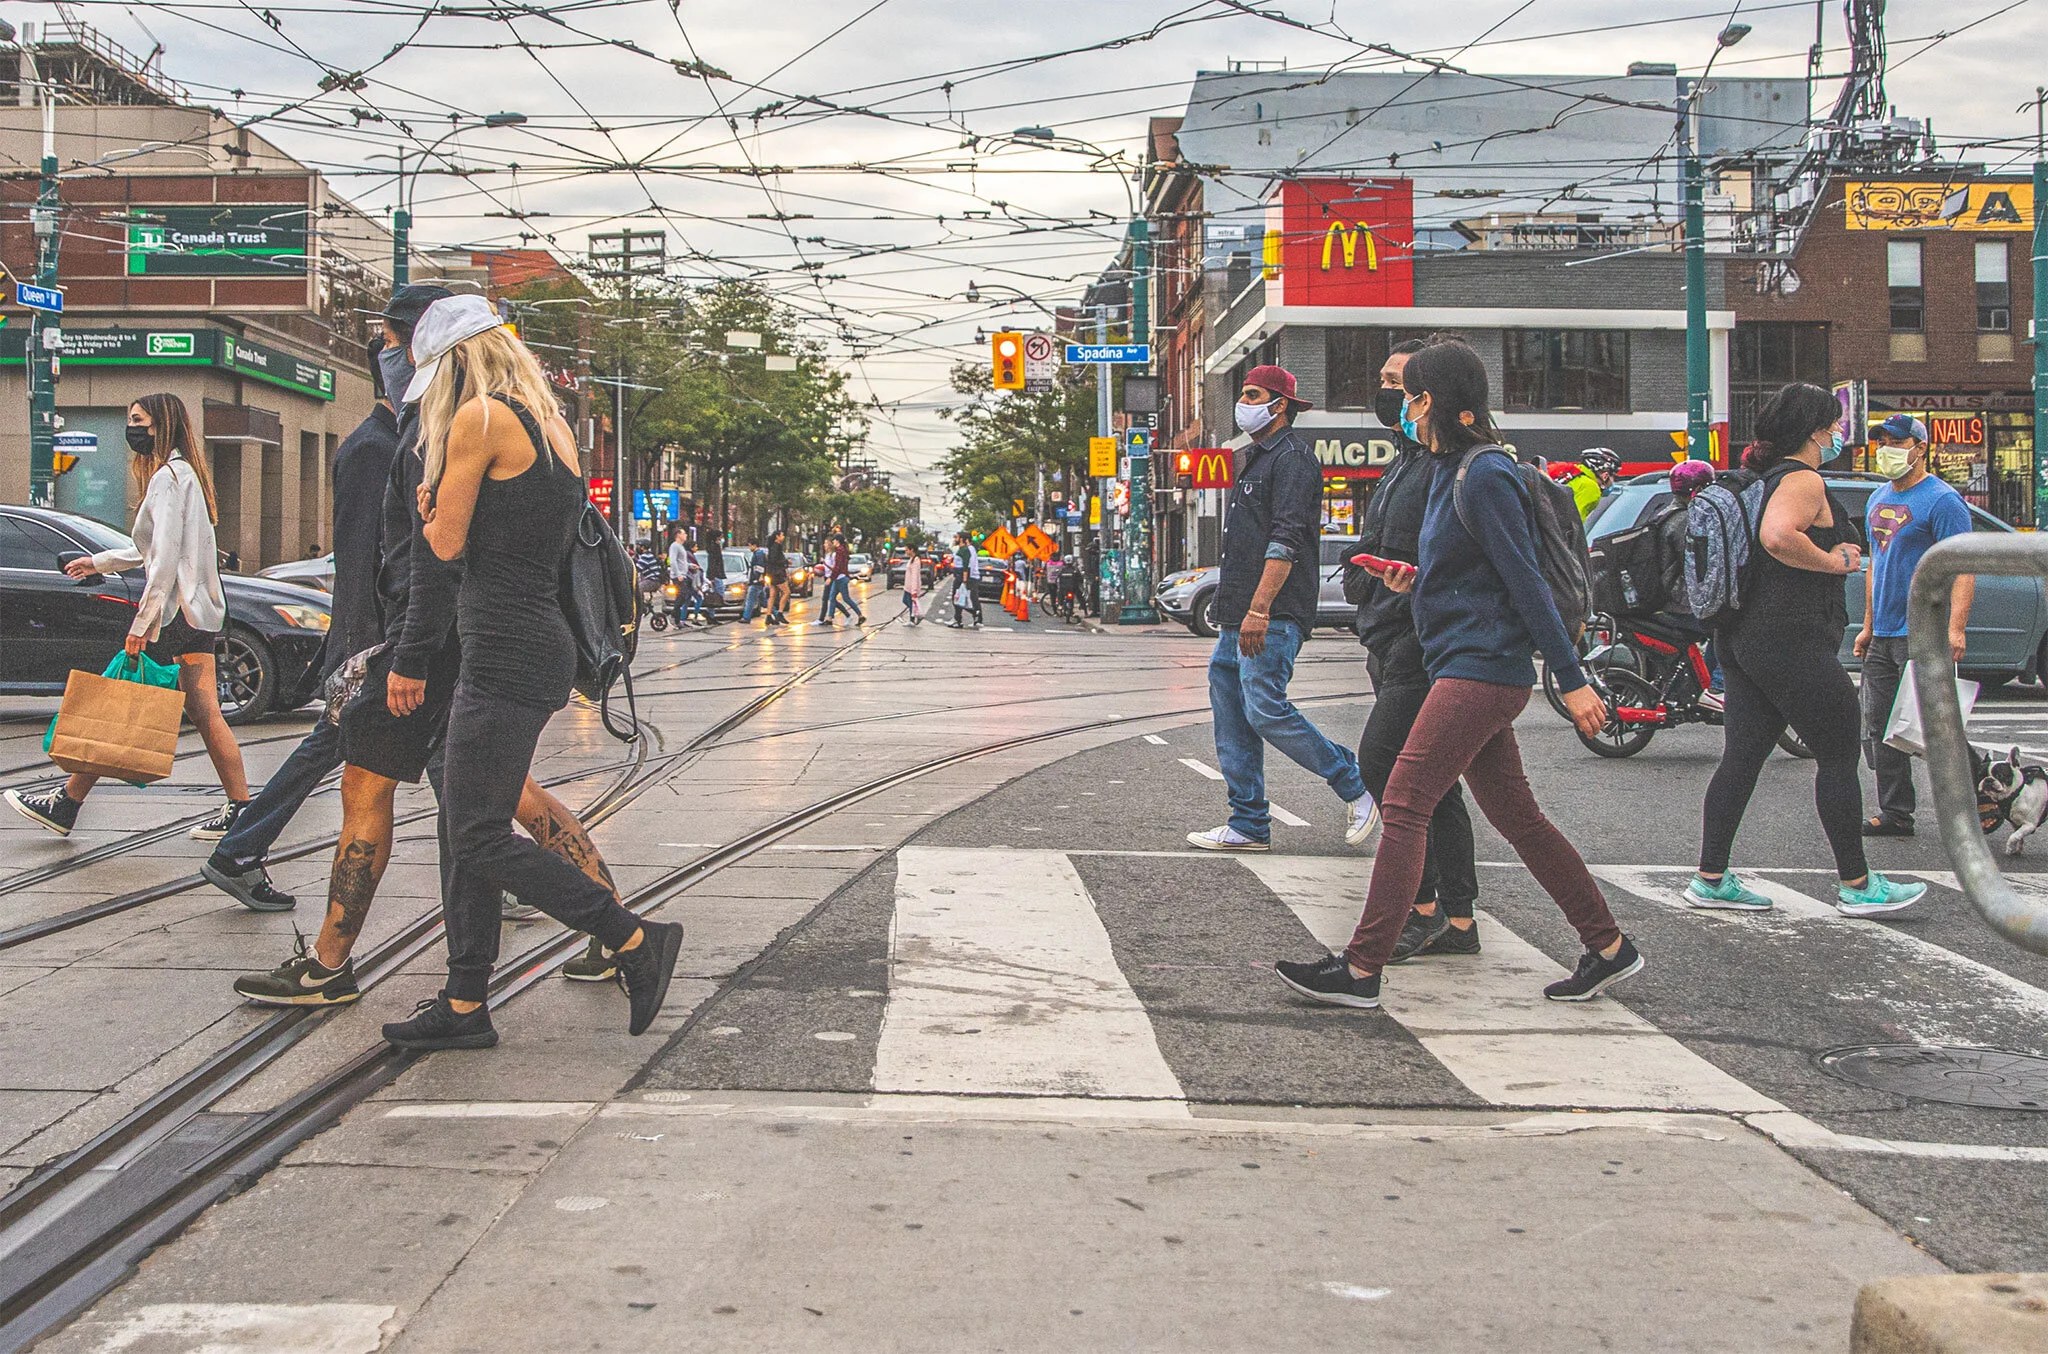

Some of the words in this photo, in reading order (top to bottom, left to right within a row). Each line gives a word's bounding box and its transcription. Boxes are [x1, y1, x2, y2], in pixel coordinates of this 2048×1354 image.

[171, 231, 224, 243] Canada
[227, 232, 267, 243] Trust
[22, 286, 45, 304] Queen
[50, 292, 57, 306] W
[82, 334, 118, 342] Wednesday
[235, 345, 254, 362] Canada
[253, 351, 267, 367] Trust
[1077, 347, 1123, 360] Spadina
[1900, 396, 1983, 408] NAILS
[1932, 417, 1983, 444] NAILS
[58, 437, 83, 445] Spadina
[1313, 439, 1400, 466] McD
